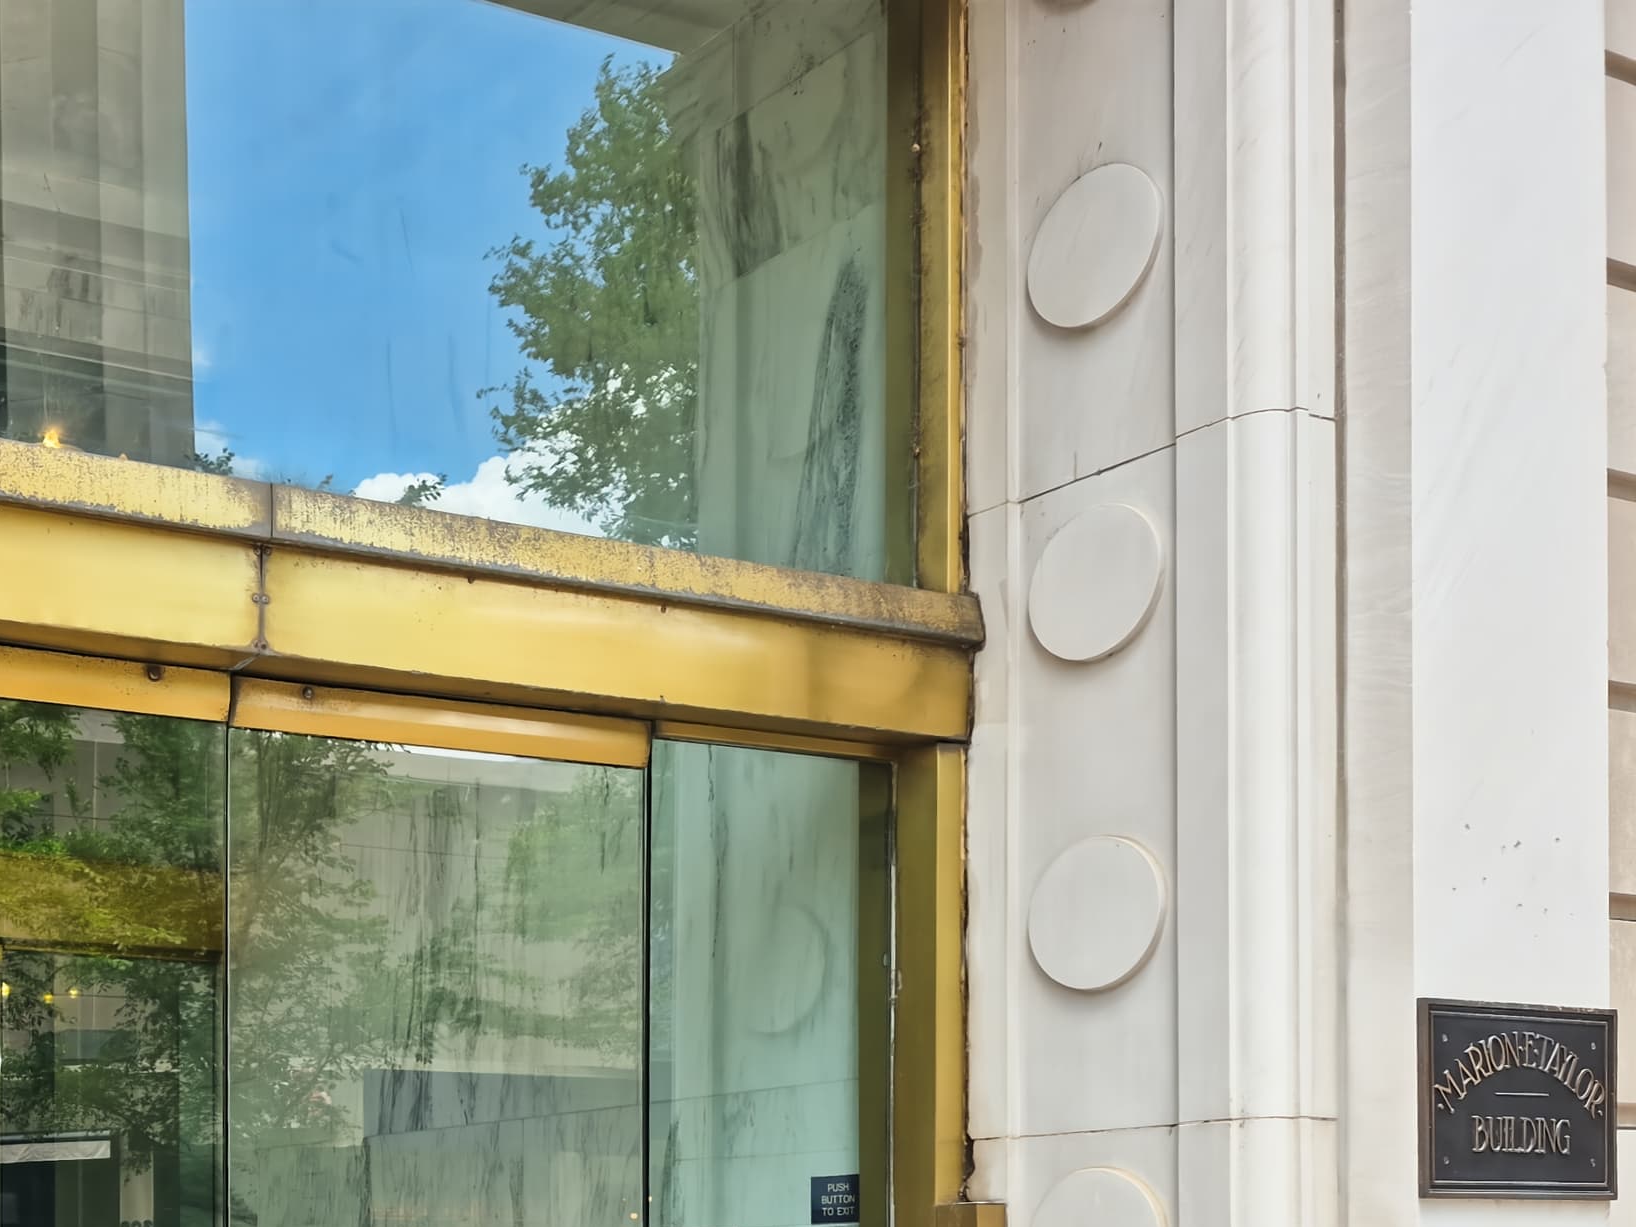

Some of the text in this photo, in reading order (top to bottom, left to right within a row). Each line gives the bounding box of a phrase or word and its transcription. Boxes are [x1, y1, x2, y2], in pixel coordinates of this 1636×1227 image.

[1471, 1115, 1571, 1155] BUILDING
[827, 1183, 849, 1192] PUSH
[821, 1194, 855, 1205] BUTTON
[822, 1206, 855, 1216] TO EXIT
